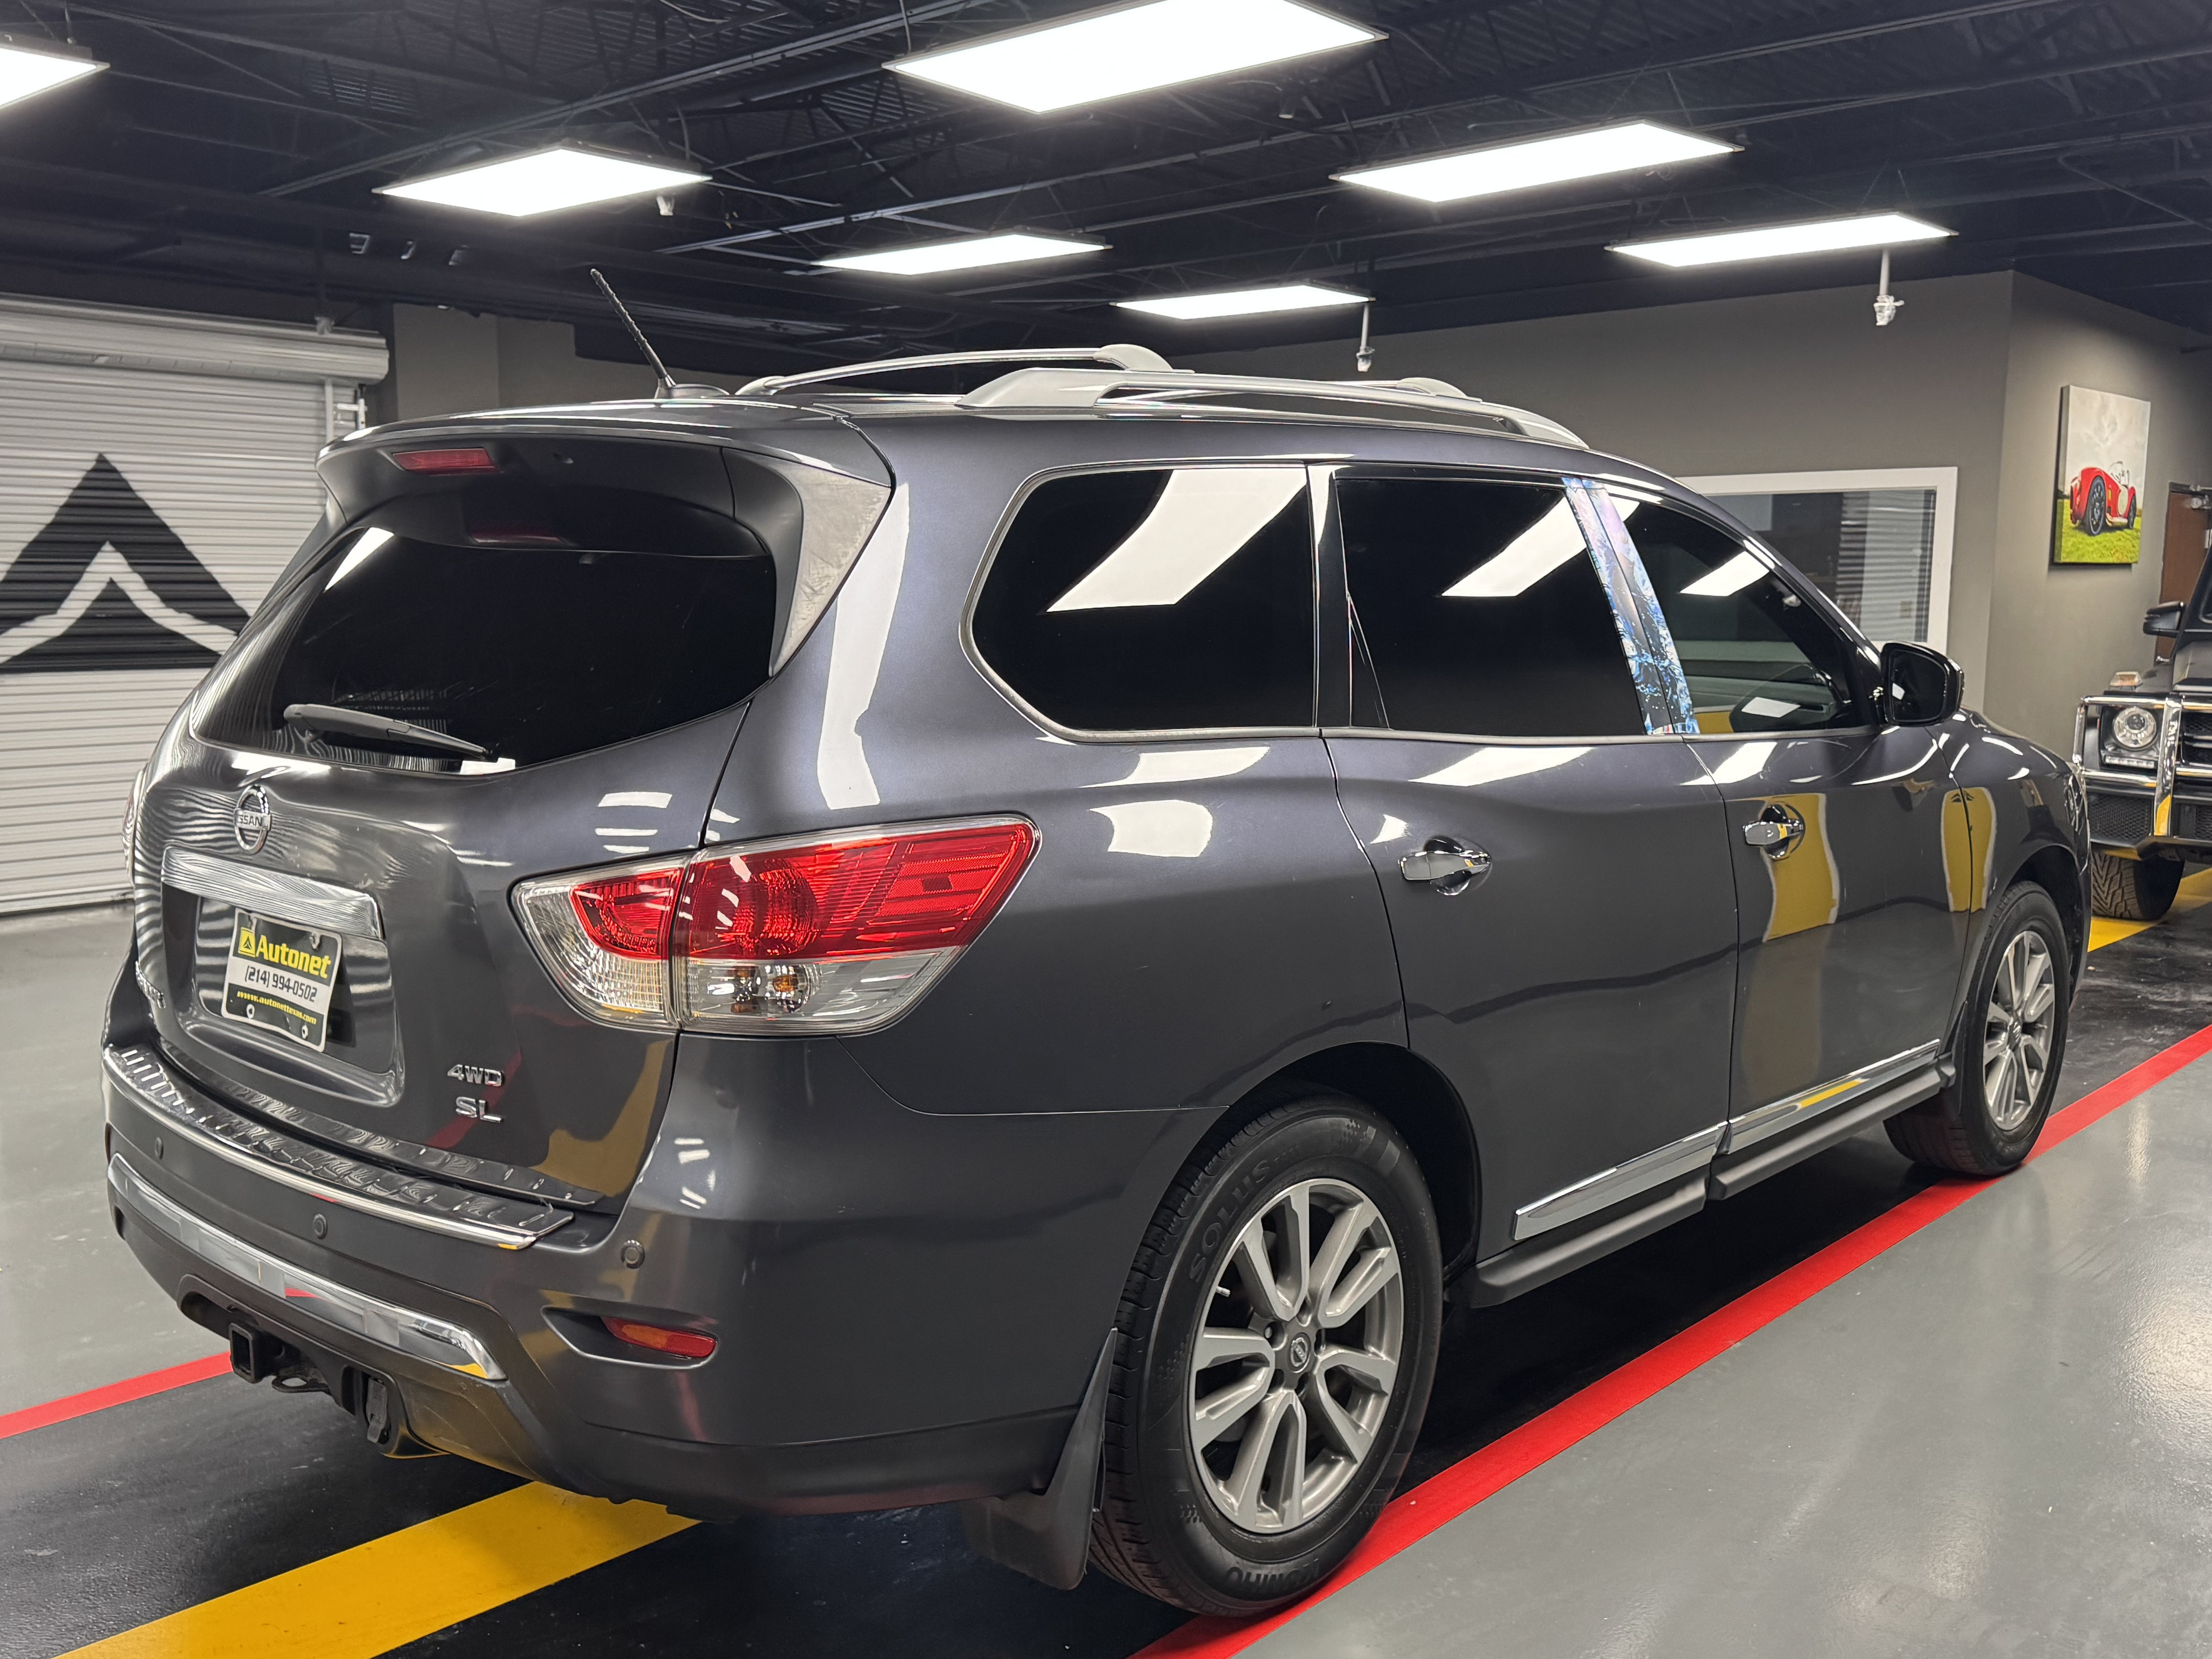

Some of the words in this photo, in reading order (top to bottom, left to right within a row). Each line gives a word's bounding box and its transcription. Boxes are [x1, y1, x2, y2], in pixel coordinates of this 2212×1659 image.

[236, 814, 262, 826] SSAN
[256, 935, 331, 979] Autonet
[245, 965, 270, 988] (214)
[272, 974, 318, 1002] 994-0502
[237, 991, 317, 1025] www.autonettexas.com
[447, 1064, 502, 1087] 4WD
[455, 1096, 502, 1123] SL
[1190, 1160, 1270, 1282] SOLUS
[1226, 1559, 1319, 1591] KUMHO
